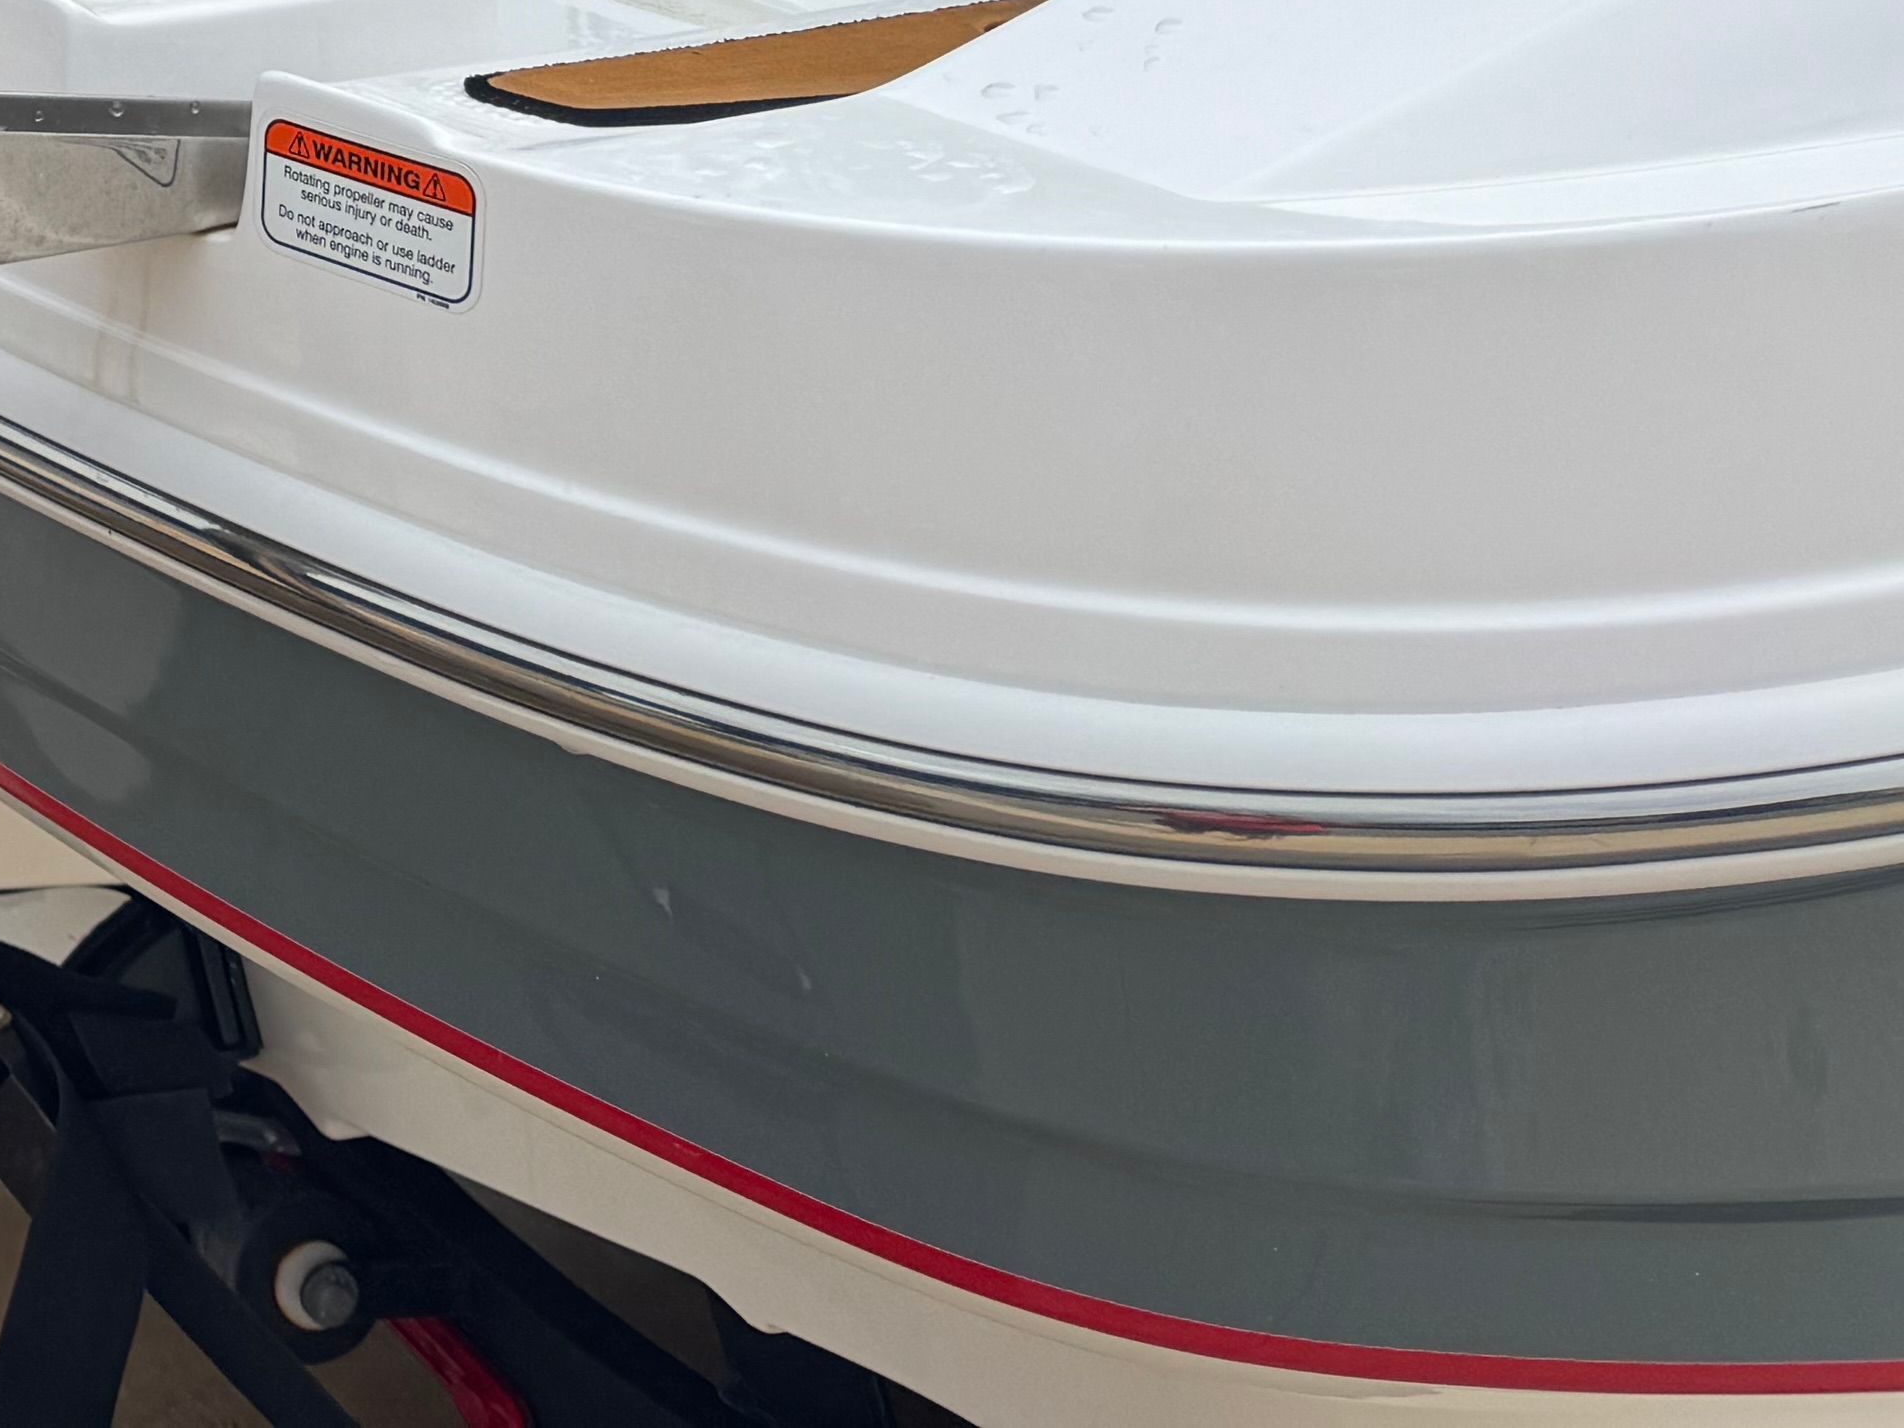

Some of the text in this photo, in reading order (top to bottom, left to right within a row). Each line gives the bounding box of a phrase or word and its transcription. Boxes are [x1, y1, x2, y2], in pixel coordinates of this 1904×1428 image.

[312, 140, 421, 191] WARNING
[284, 166, 454, 232] Rotating propeller may cause
[300, 189, 431, 241] serious injury or death.
[279, 204, 455, 275] Do not approach or use ladder
[296, 228, 434, 286] when engine is running.
